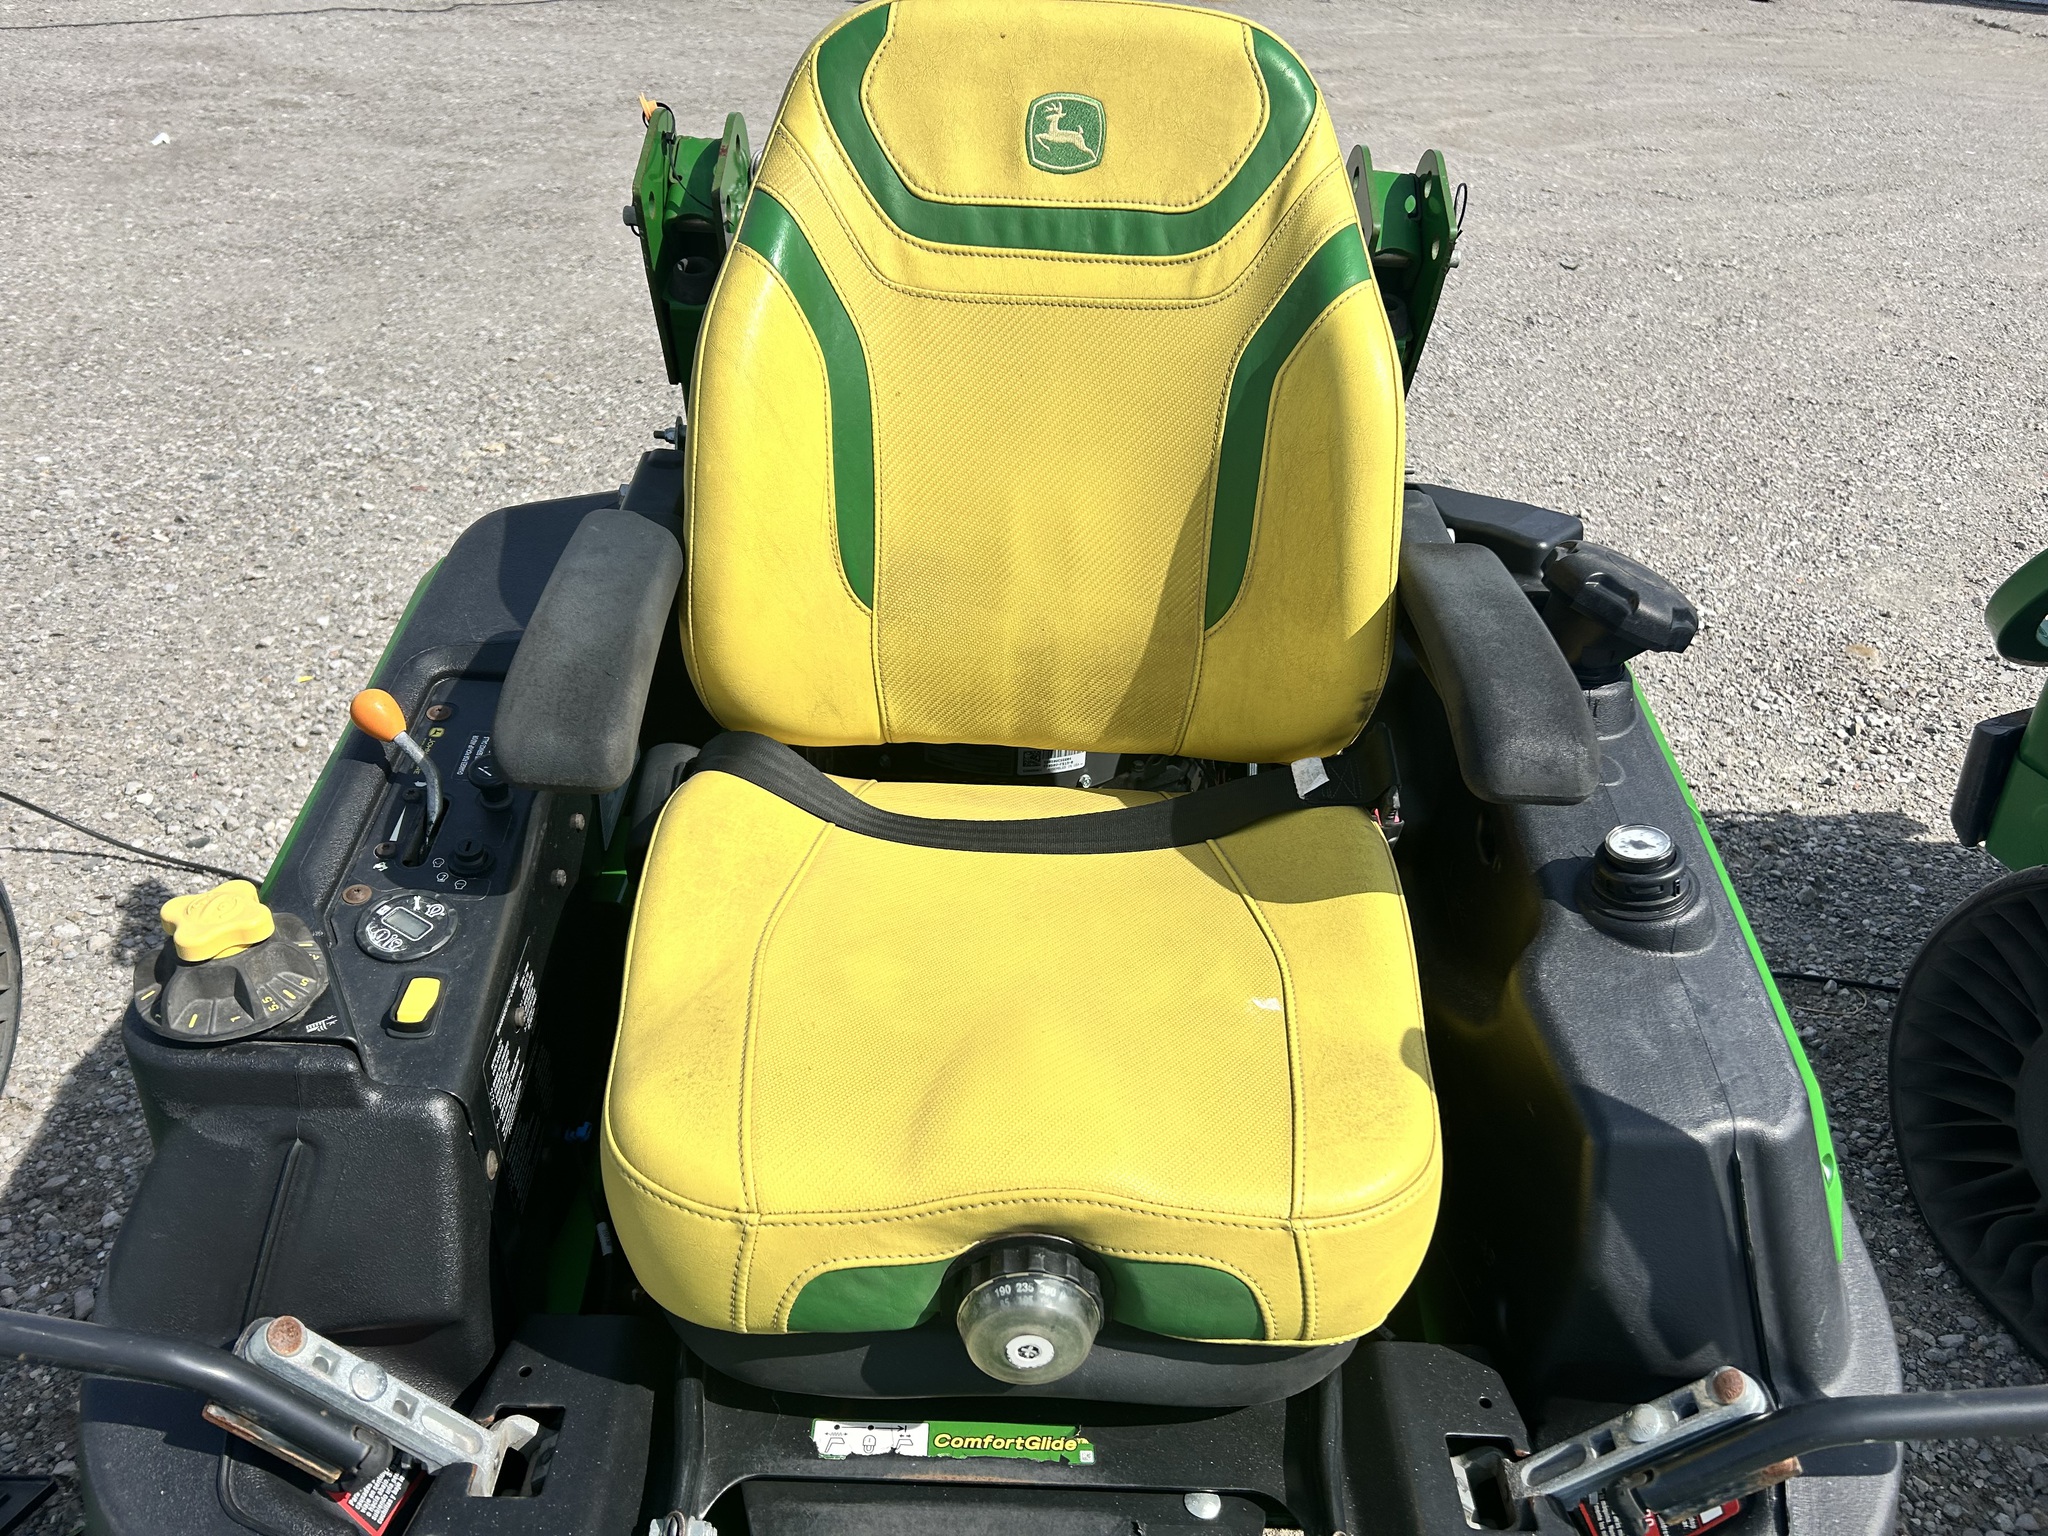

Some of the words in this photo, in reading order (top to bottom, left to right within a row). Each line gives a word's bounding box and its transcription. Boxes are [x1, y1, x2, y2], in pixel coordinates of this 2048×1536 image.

[300, 978, 309, 987] 5
[261, 996, 280, 1012] 5.5
[994, 1283, 1012, 1298] 190
[1015, 1282, 1035, 1293] 235
